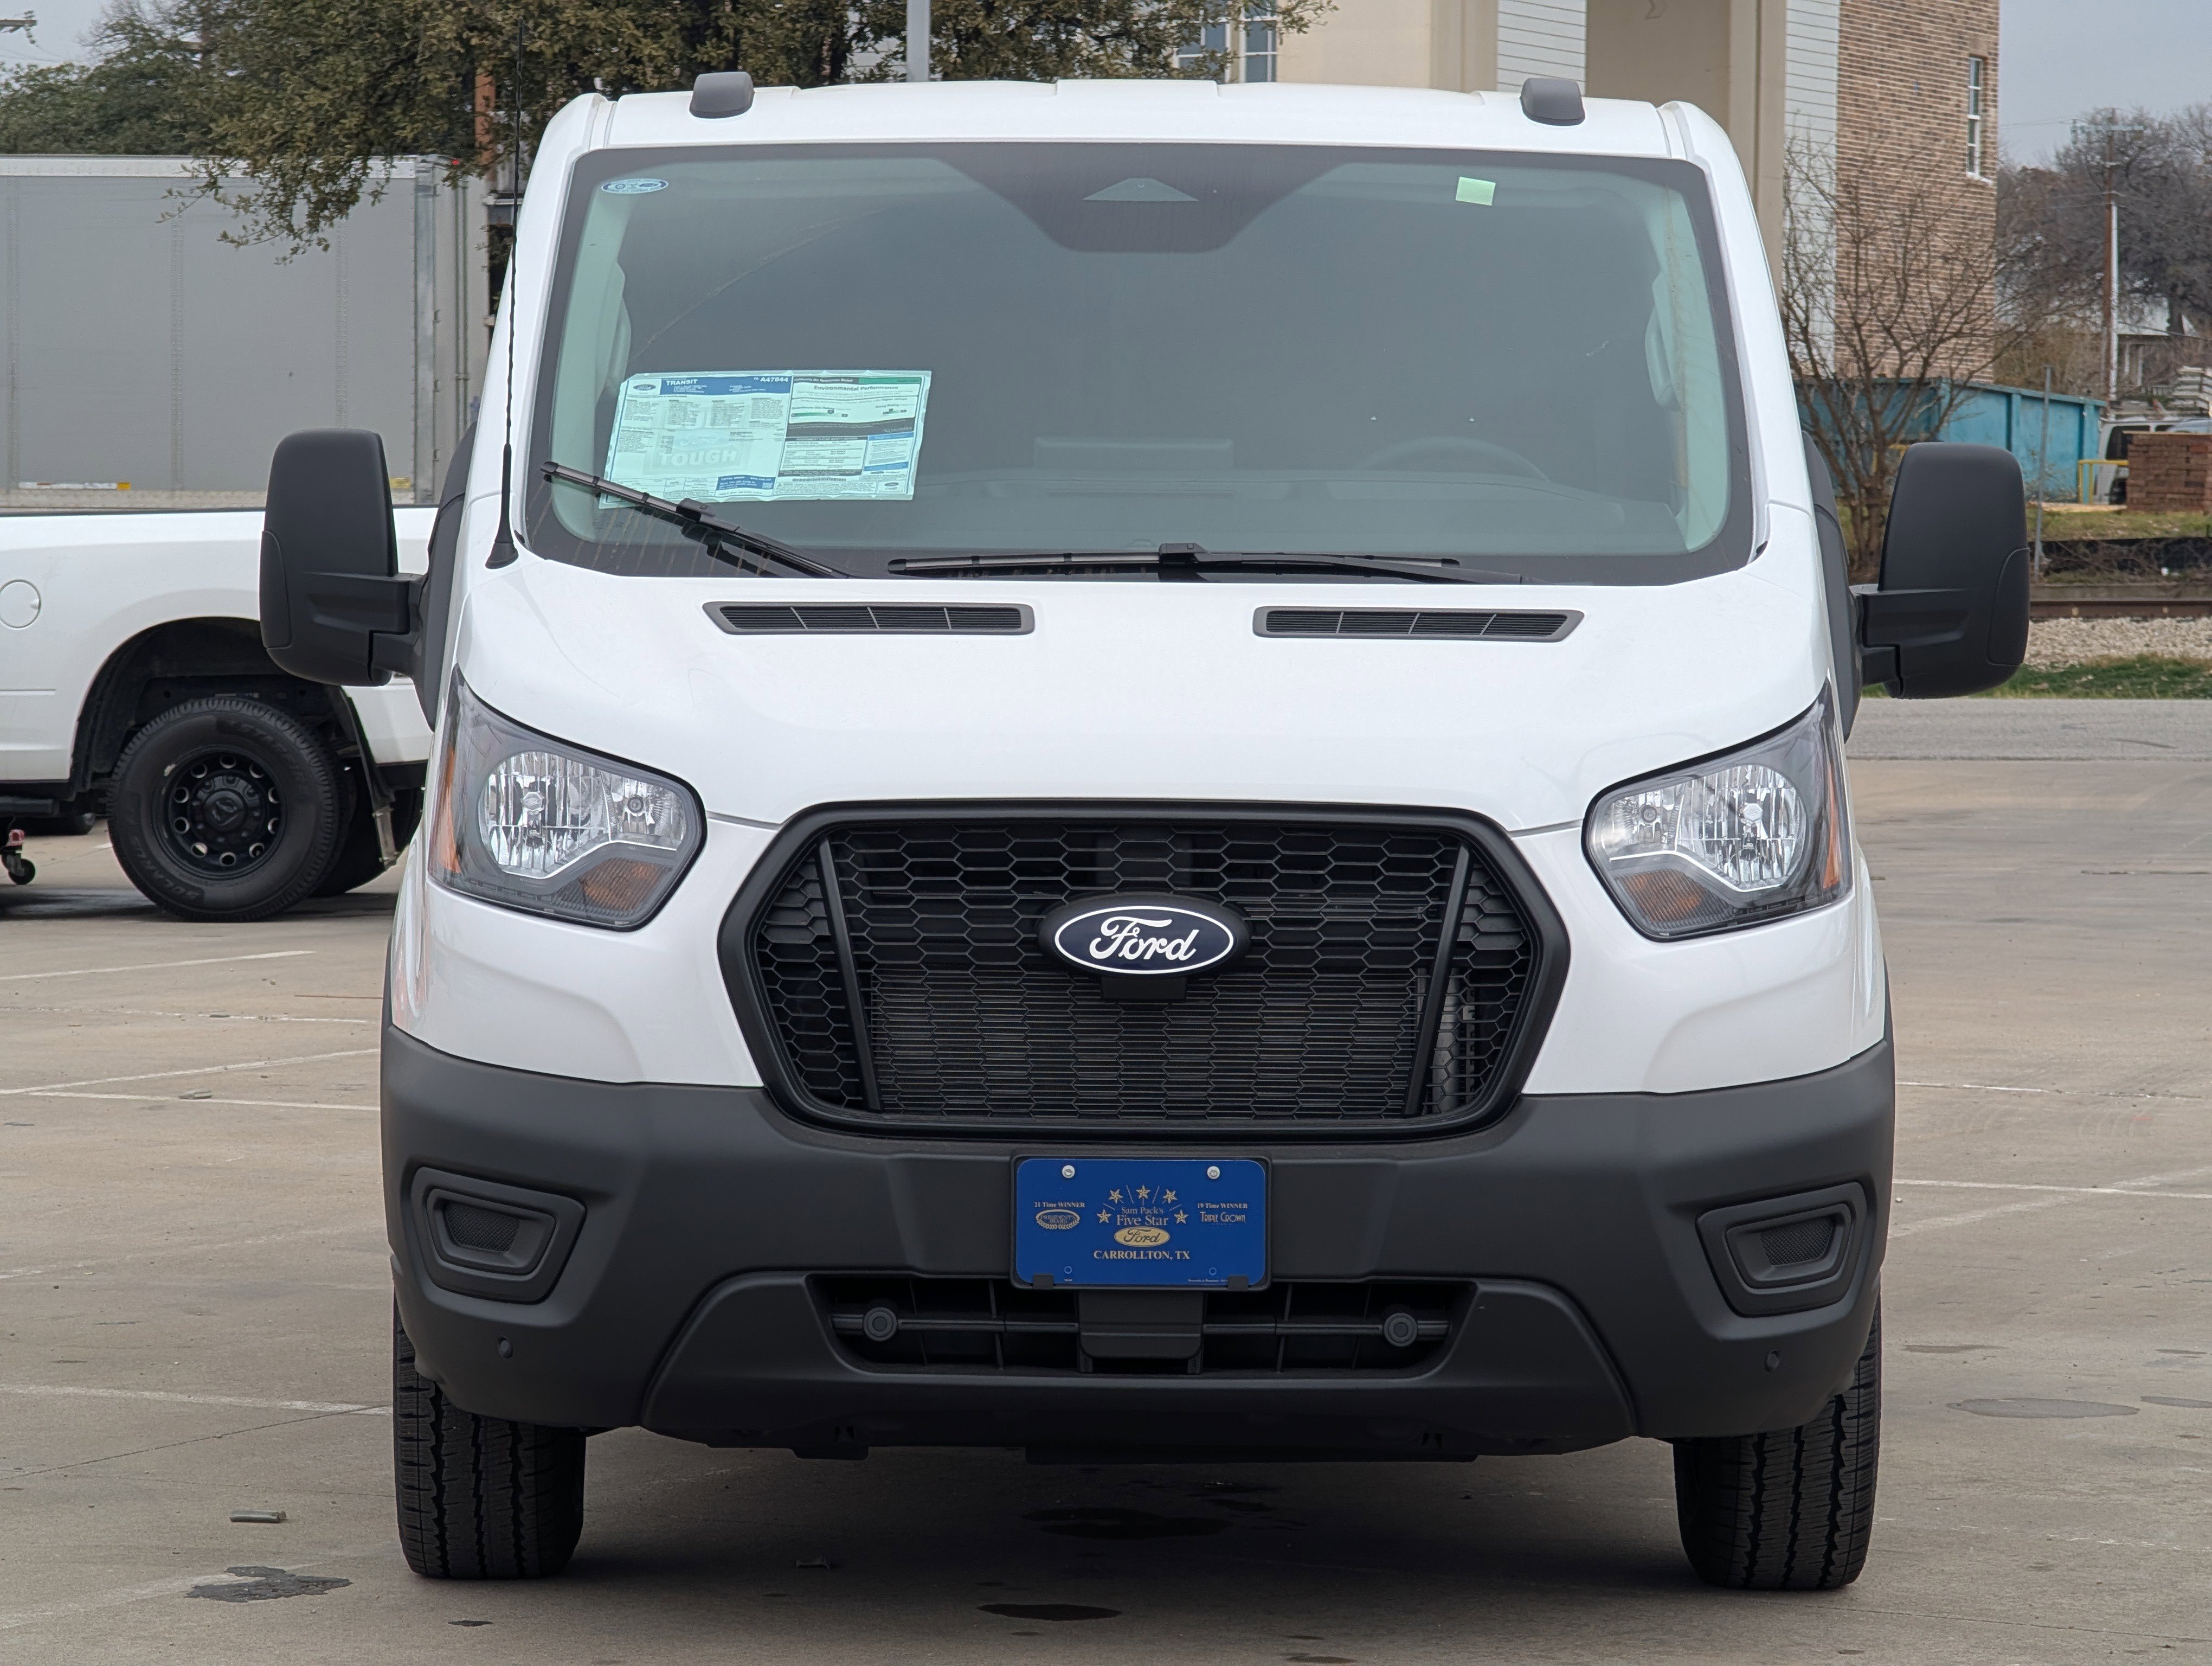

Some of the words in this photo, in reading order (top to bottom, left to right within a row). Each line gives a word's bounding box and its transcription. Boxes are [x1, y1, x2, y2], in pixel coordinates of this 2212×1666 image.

[657, 450, 738, 466] TOUGH
[1089, 916, 1199, 960] Ford
[1116, 1215, 1141, 1226] Five
[1145, 1214, 1169, 1226] Star
[1123, 1228, 1161, 1242] Ford
[1094, 1251, 1173, 1260] CARROLLTON,
[1174, 1251, 1191, 1260] TX
